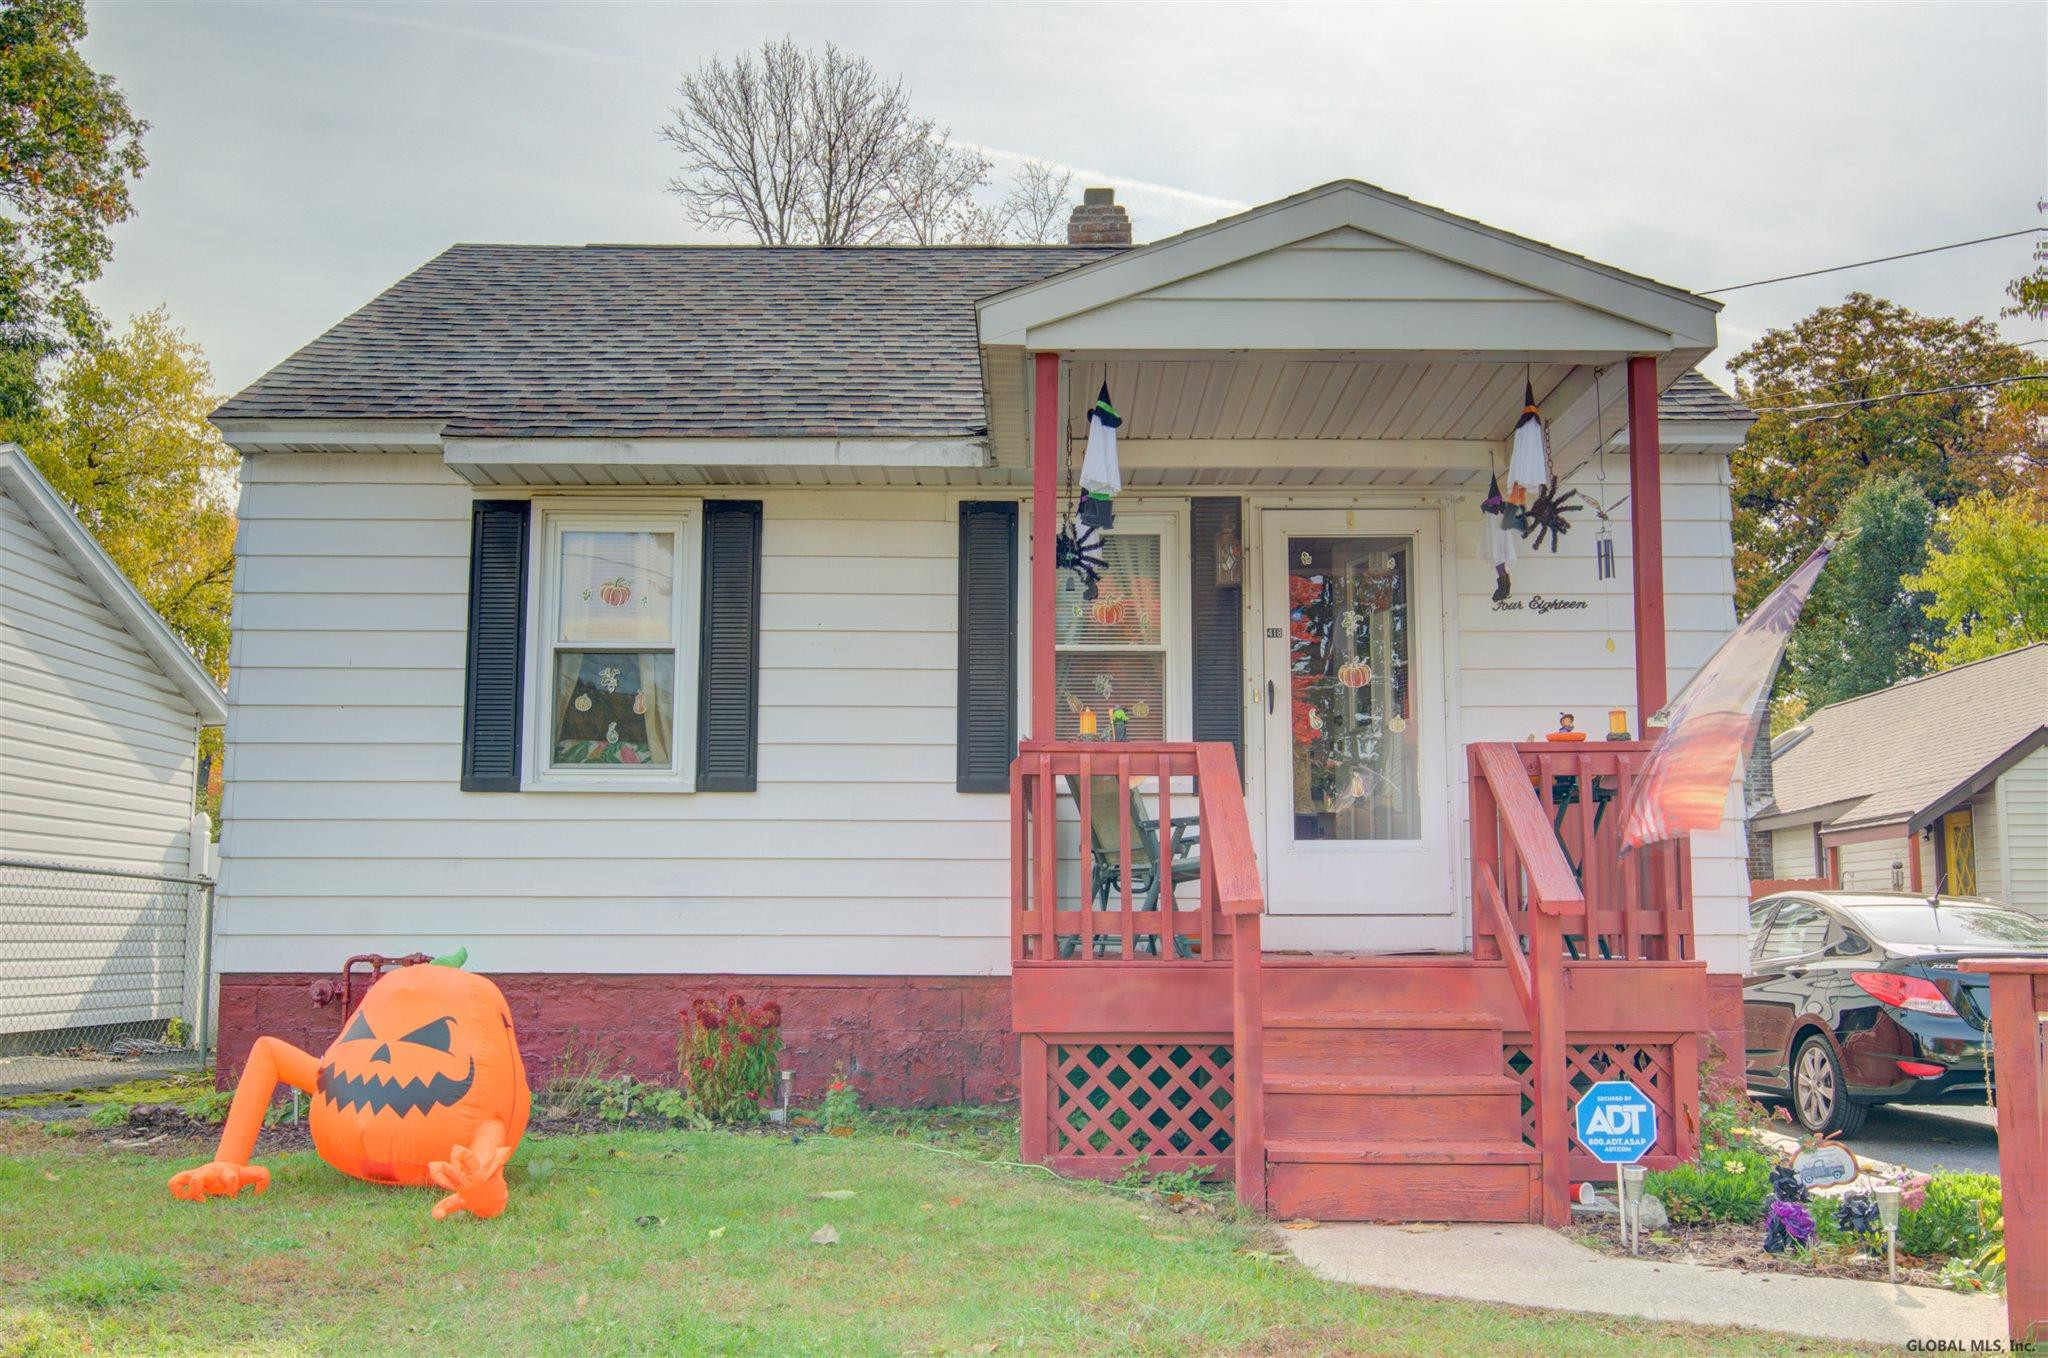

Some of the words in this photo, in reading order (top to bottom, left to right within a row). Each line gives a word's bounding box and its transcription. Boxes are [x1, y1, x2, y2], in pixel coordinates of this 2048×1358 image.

[1492, 600, 1524, 611] Four
[1528, 595, 1588, 615] Eighteen
[1267, 628, 1282, 637] 418
[1586, 1105, 1647, 1135] ADT
[1588, 1138, 1647, 1146] 800.ADT.ASAP
